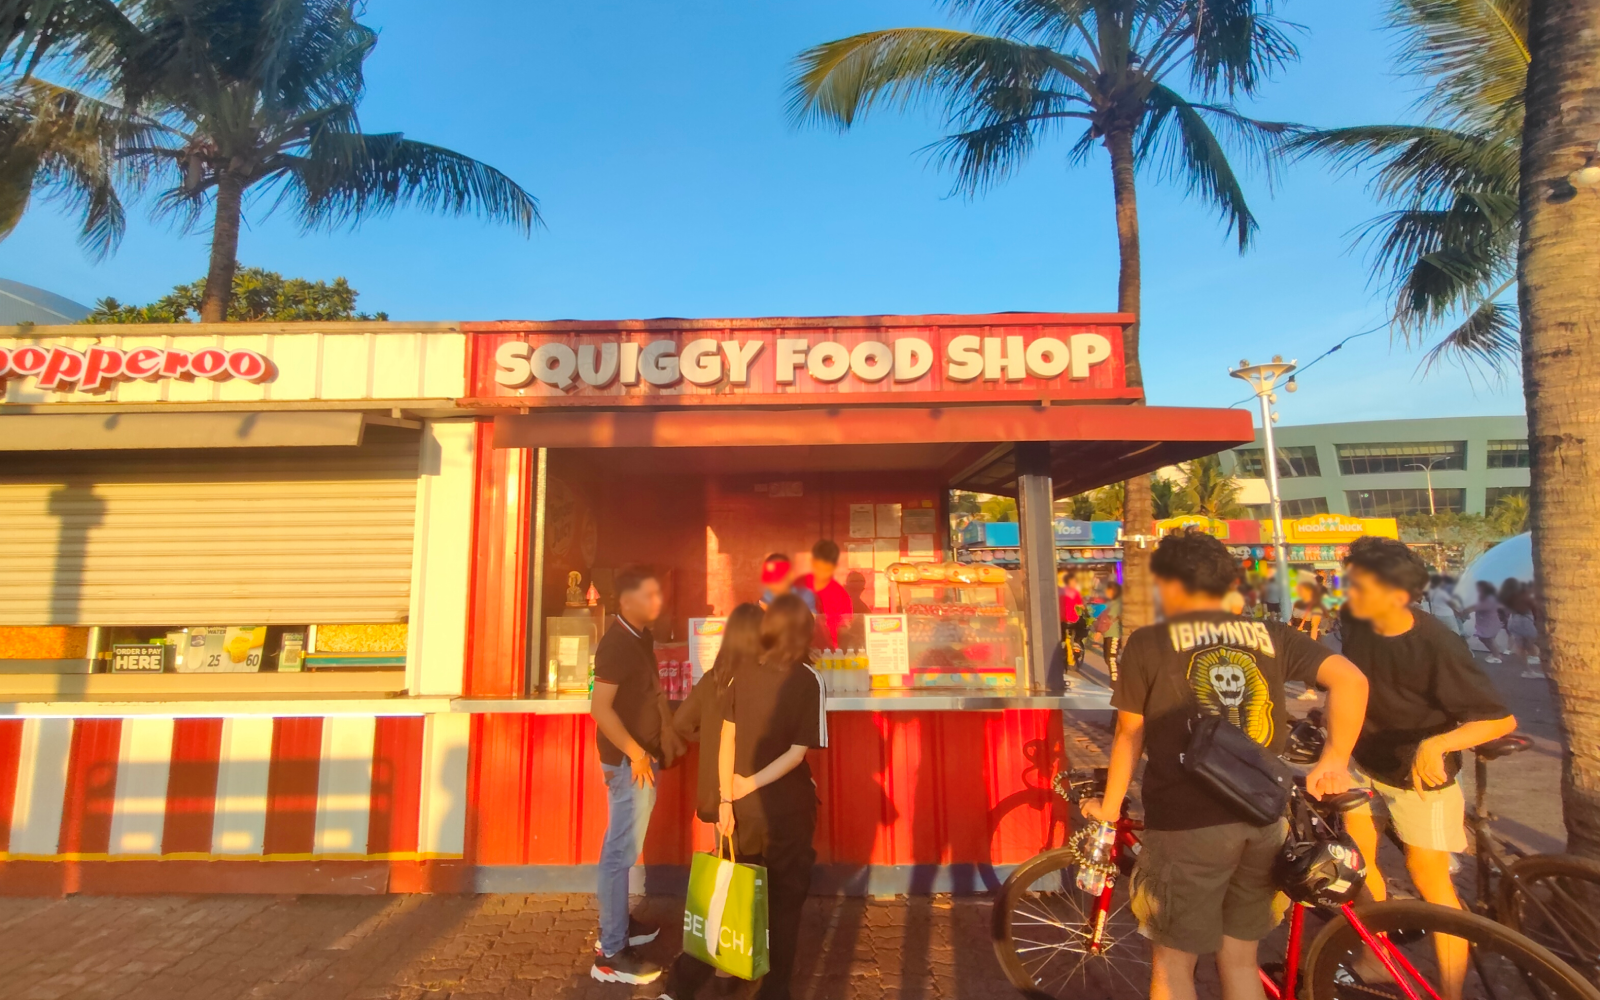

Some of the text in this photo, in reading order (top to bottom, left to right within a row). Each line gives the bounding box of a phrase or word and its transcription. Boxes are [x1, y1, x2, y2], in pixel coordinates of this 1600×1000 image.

[0, 344, 267, 391] opperoo
[494, 332, 1112, 390] SQUIGGY FOOD SHOP
[1297, 523, 1326, 532] HOOK
[1338, 523, 1364, 532] DUCK
[115, 655, 161, 670] HERE
[207, 654, 222, 667] 25
[246, 654, 260, 667] 60
